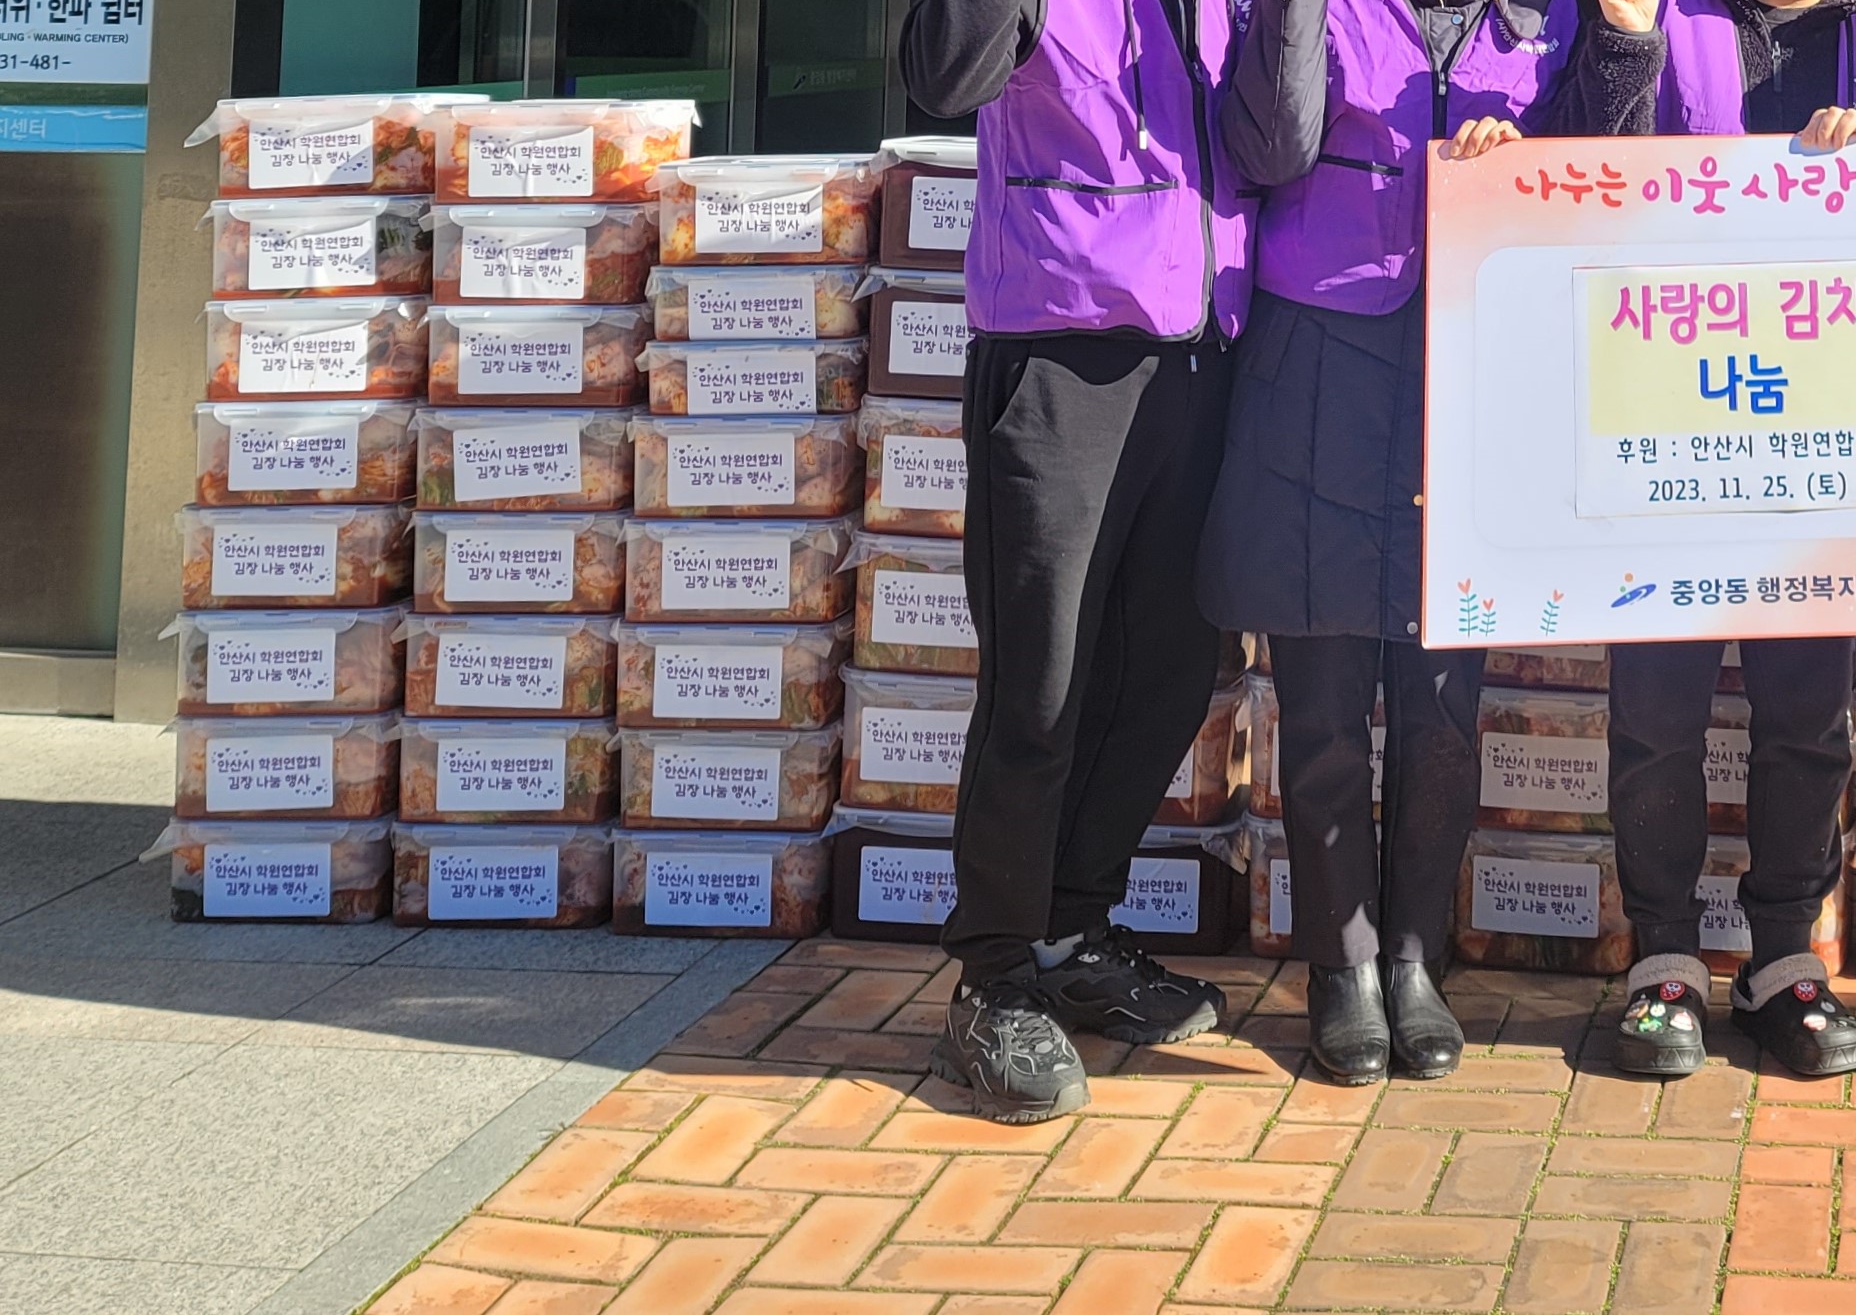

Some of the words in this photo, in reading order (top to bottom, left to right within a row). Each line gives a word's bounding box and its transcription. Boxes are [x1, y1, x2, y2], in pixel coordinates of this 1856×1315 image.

[33, 33, 81, 43] WARMING
[84, 34, 129, 44] CENTER)
[1515, 163, 1627, 208] 나누는
[1643, 157, 1730, 214] 이웃
[1610, 279, 1750, 344] 사랑의
[1699, 355, 1789, 414] 나눔
[464, 448, 502, 463] 안산시
[505, 442, 569, 460] 학원연합회
[1616, 437, 1659, 464] 후원
[1691, 434, 1754, 462] 안산시
[475, 464, 502, 480] 김장
[504, 463, 530, 478] 나눔
[533, 460, 559, 474] 행사
[678, 455, 716, 469] 안산시
[720, 453, 783, 467] 학원연합회
[689, 472, 715, 486] 김장
[718, 472, 744, 485] 나눔
[747, 471, 773, 484] 행사
[1648, 478, 1707, 503] 2023.
[1719, 477, 1751, 501] 11.
[1762, 475, 1795, 500] 25.
[1807, 471, 1847, 501] (토)
[456, 550, 495, 563] 안산시
[498, 549, 562, 563] 학원연합회
[467, 567, 493, 581] 김장
[496, 568, 522, 581] 나눔
[525, 567, 551, 580] 행사
[1670, 578, 1749, 606] 중앙동
[448, 655, 486, 668] 안산시
[489, 655, 553, 670] 학원연합회
[458, 672, 484, 686] 김장
[487, 673, 513, 687] 나눔
[515, 673, 542, 687] 행사
[664, 766, 702, 780] 안산시
[705, 767, 768, 781] 학원연합회
[1491, 755, 1530, 770] 안산시
[1533, 757, 1598, 774] 학원연합회
[673, 783, 700, 797] 김장
[702, 785, 728, 798] 나눔
[731, 785, 757, 798] 행사
[1501, 773, 1528, 788] 김장
[1531, 775, 1557, 790] 나눔
[1560, 776, 1587, 791] 행사
[439, 867, 478, 881] 안산시
[482, 865, 546, 880] 학원연합회
[450, 884, 477, 898] 김장
[479, 884, 506, 898] 나눔
[509, 883, 535, 896] 행사
[1483, 878, 1520, 894] 안산시
[1524, 881, 1587, 899] 학원연합회
[1493, 896, 1519, 912] 김장
[1522, 899, 1548, 914] 나눔
[1551, 901, 1577, 915] 행사
